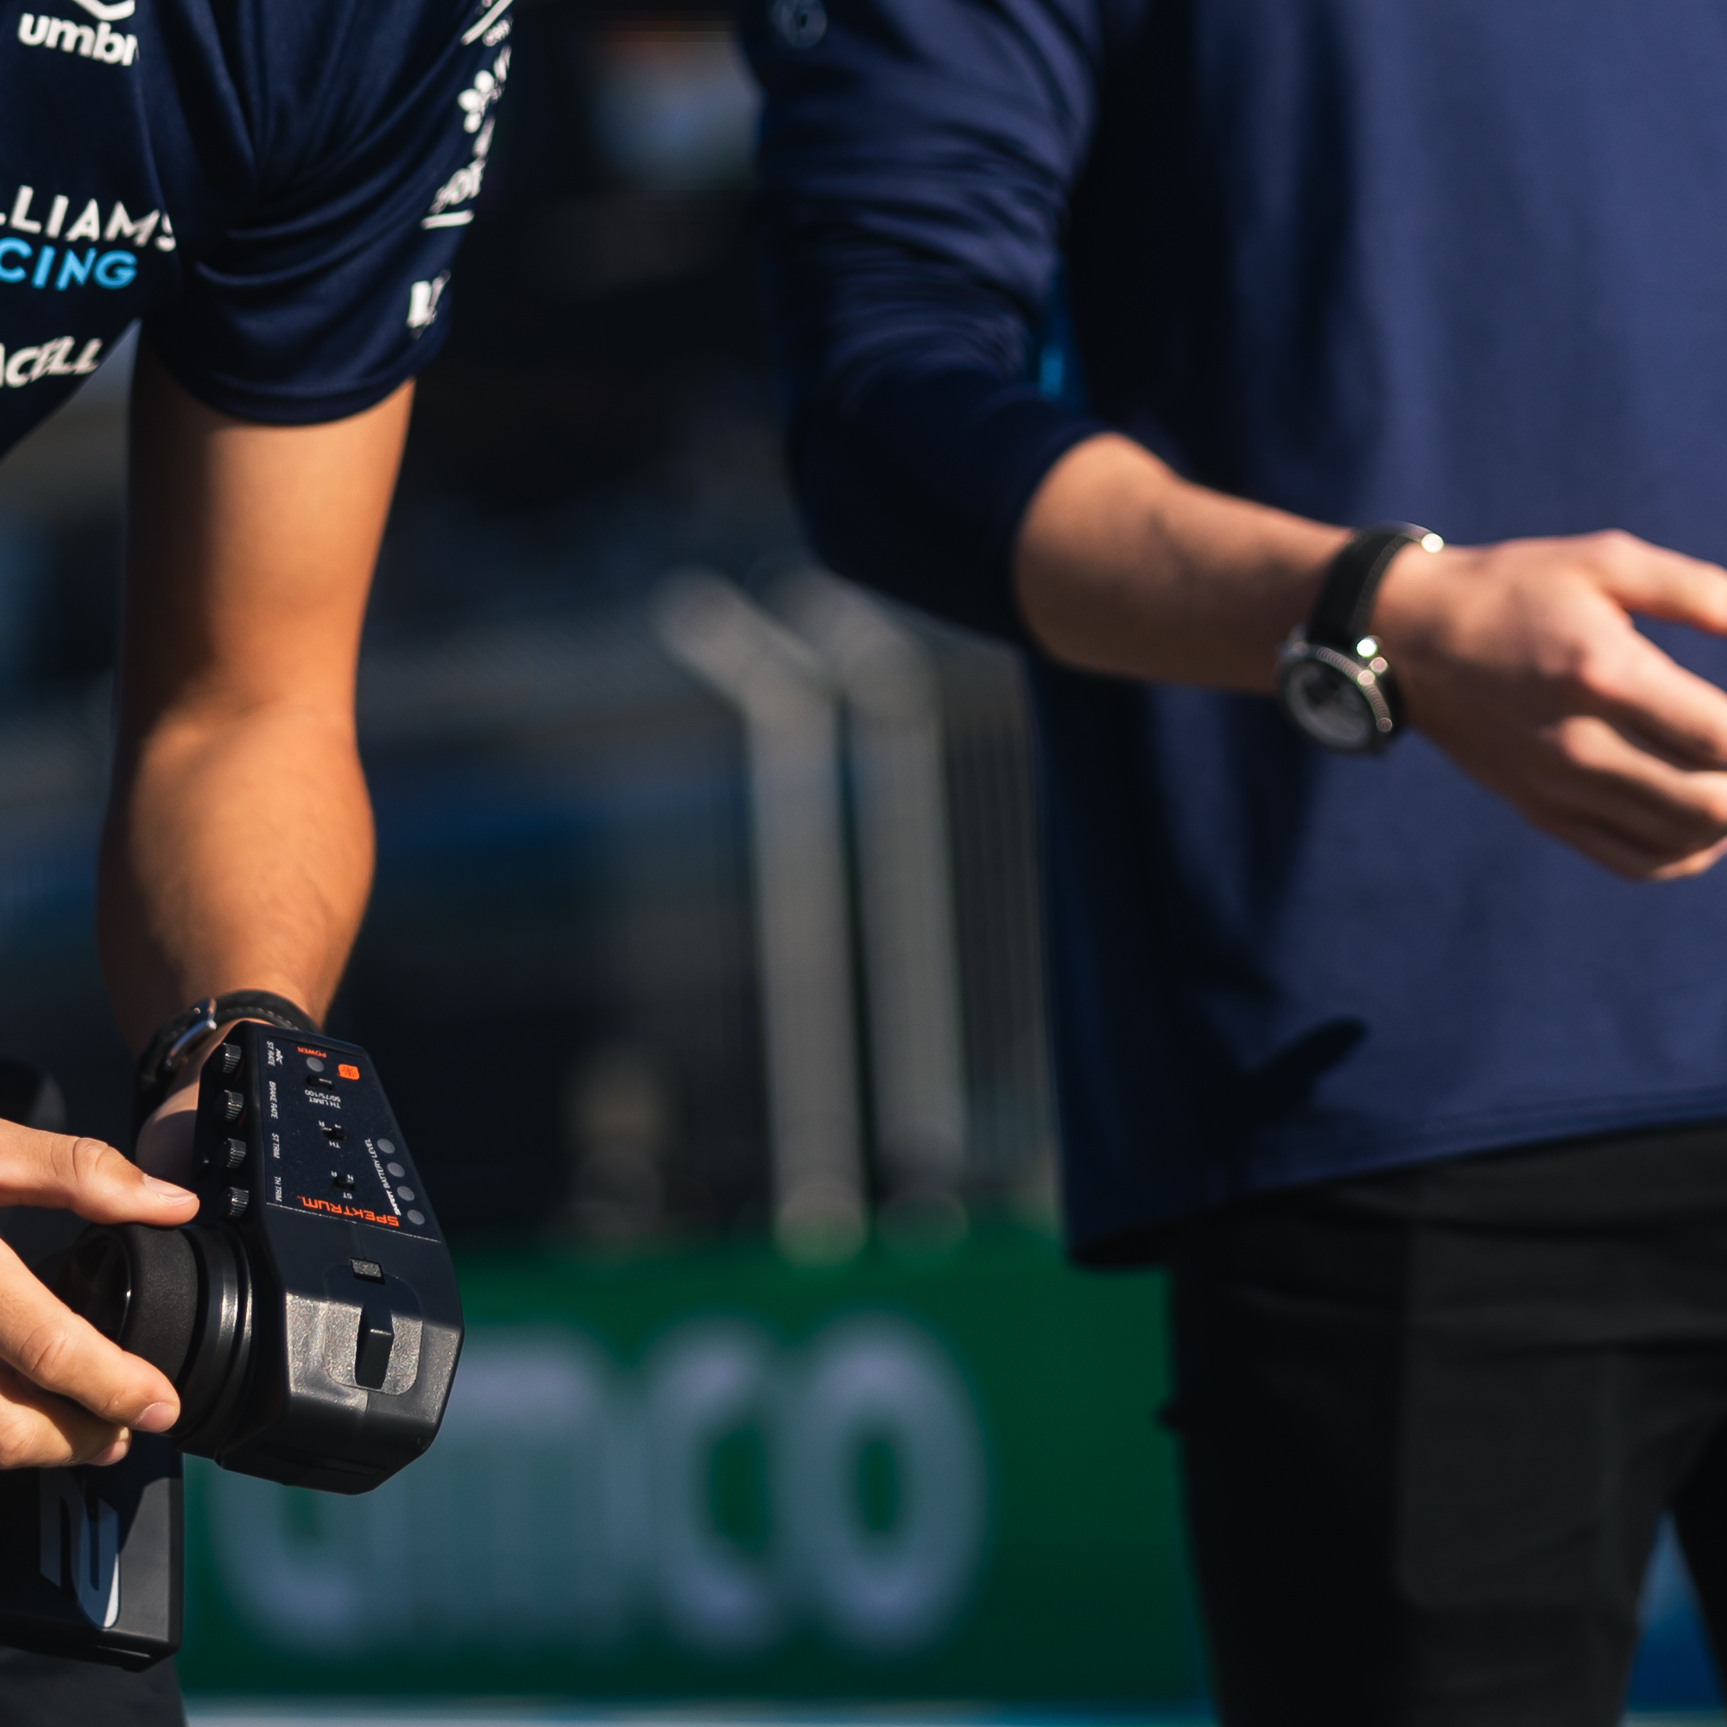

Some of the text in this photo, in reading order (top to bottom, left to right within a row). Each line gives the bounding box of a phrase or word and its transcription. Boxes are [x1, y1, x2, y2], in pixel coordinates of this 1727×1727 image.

[297, 1046, 327, 1058] POWER
[364, 1137, 378, 1159] LEVEL
[373, 1159, 391, 1189] BATTERY
[301, 1195, 400, 1227] SPEKTRUM
